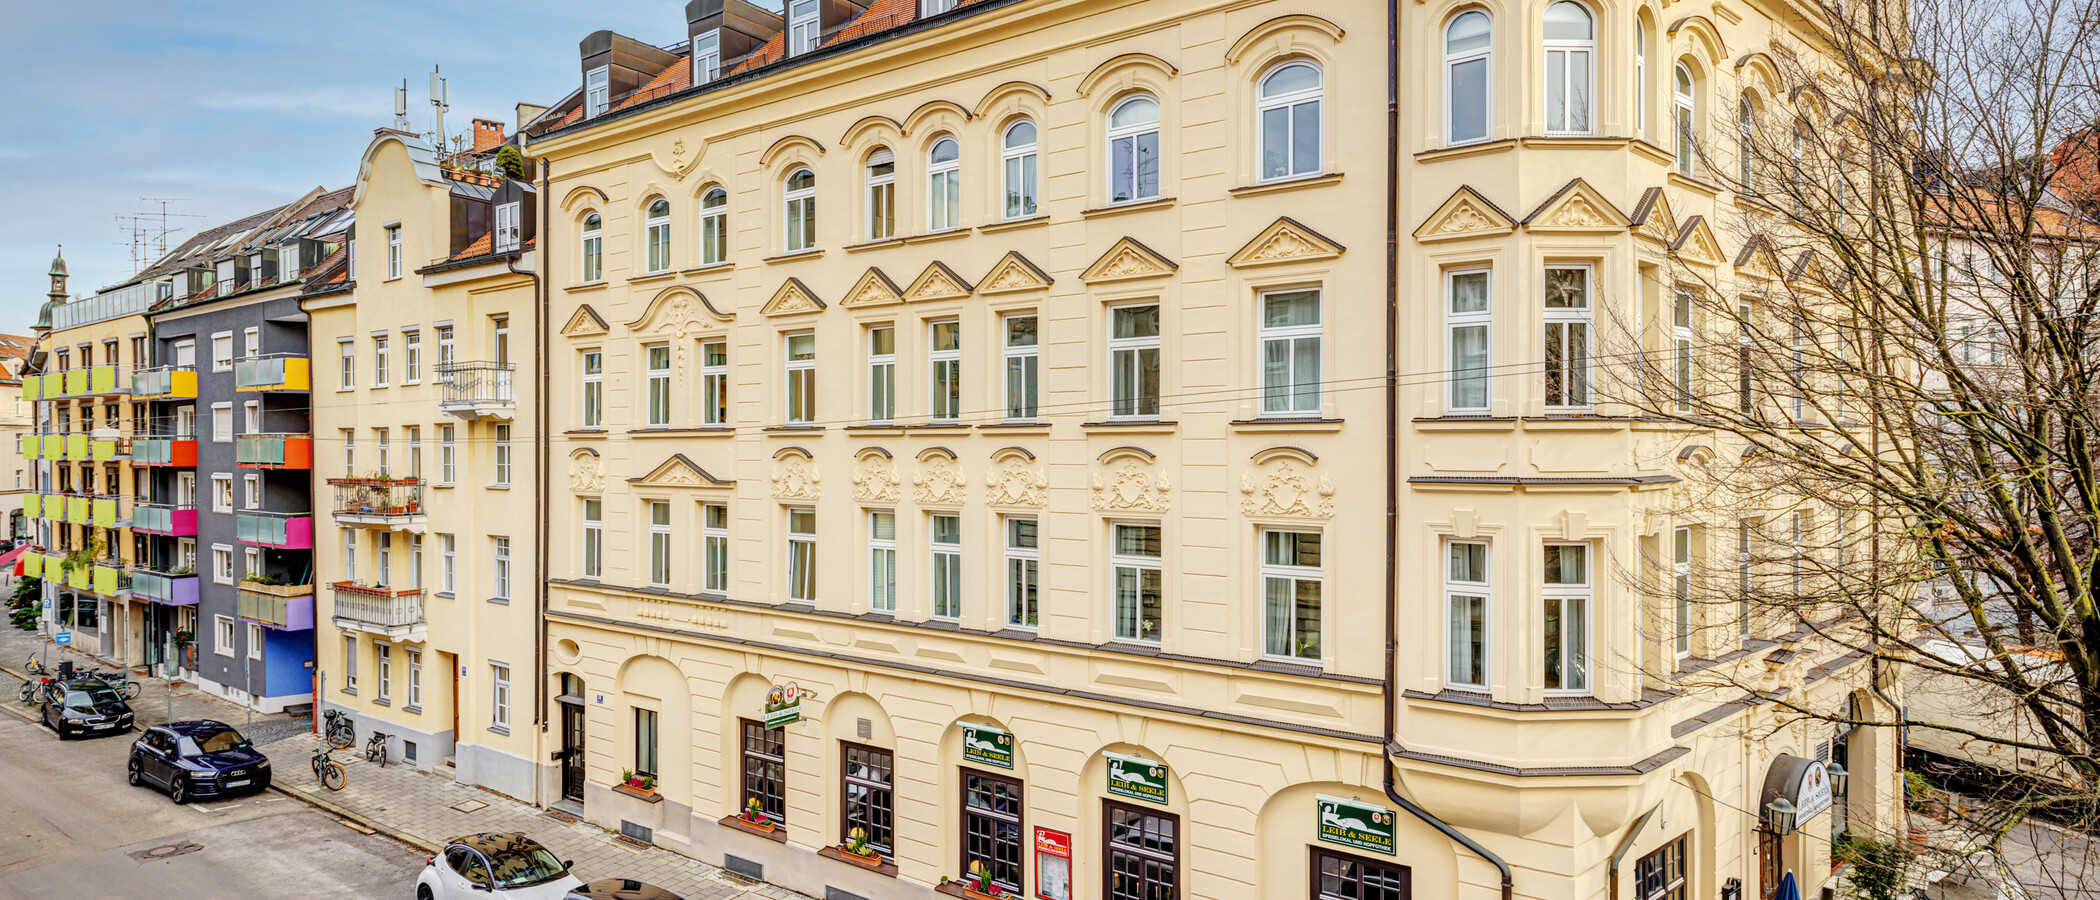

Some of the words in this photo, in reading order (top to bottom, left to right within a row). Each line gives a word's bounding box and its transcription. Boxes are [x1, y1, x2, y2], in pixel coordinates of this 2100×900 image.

[989, 752, 1010, 761] SEELE
[1111, 780, 1130, 789] LEIB
[1138, 786, 1164, 796] SEELE
[1322, 825, 1346, 836] LEIB
[1348, 831, 1356, 839] &
[1358, 833, 1392, 846] SEELE
[1322, 833, 1352, 844] SPEISELOKAL
[1363, 841, 1392, 851] HOPFOTHEK
